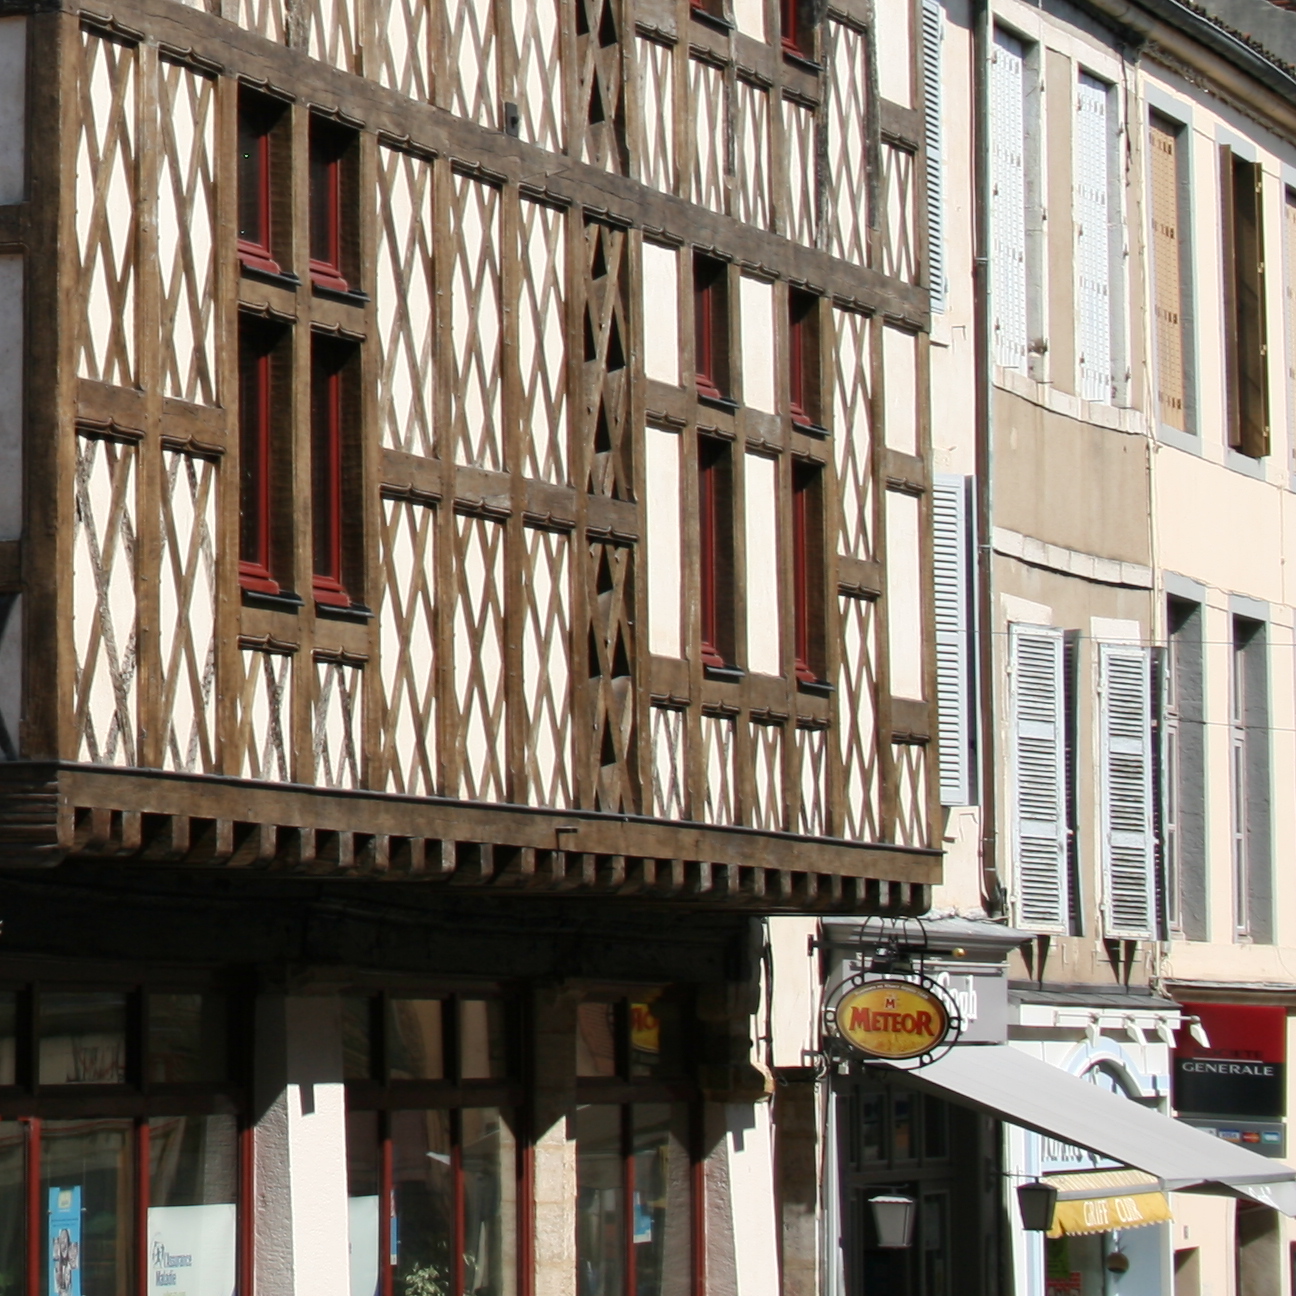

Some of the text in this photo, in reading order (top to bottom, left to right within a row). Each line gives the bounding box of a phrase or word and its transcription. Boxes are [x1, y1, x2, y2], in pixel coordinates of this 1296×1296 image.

[885, 998, 895, 1008] M
[849, 1006, 935, 1036] METEOR
[1182, 1062, 1274, 1076] GENERALE
